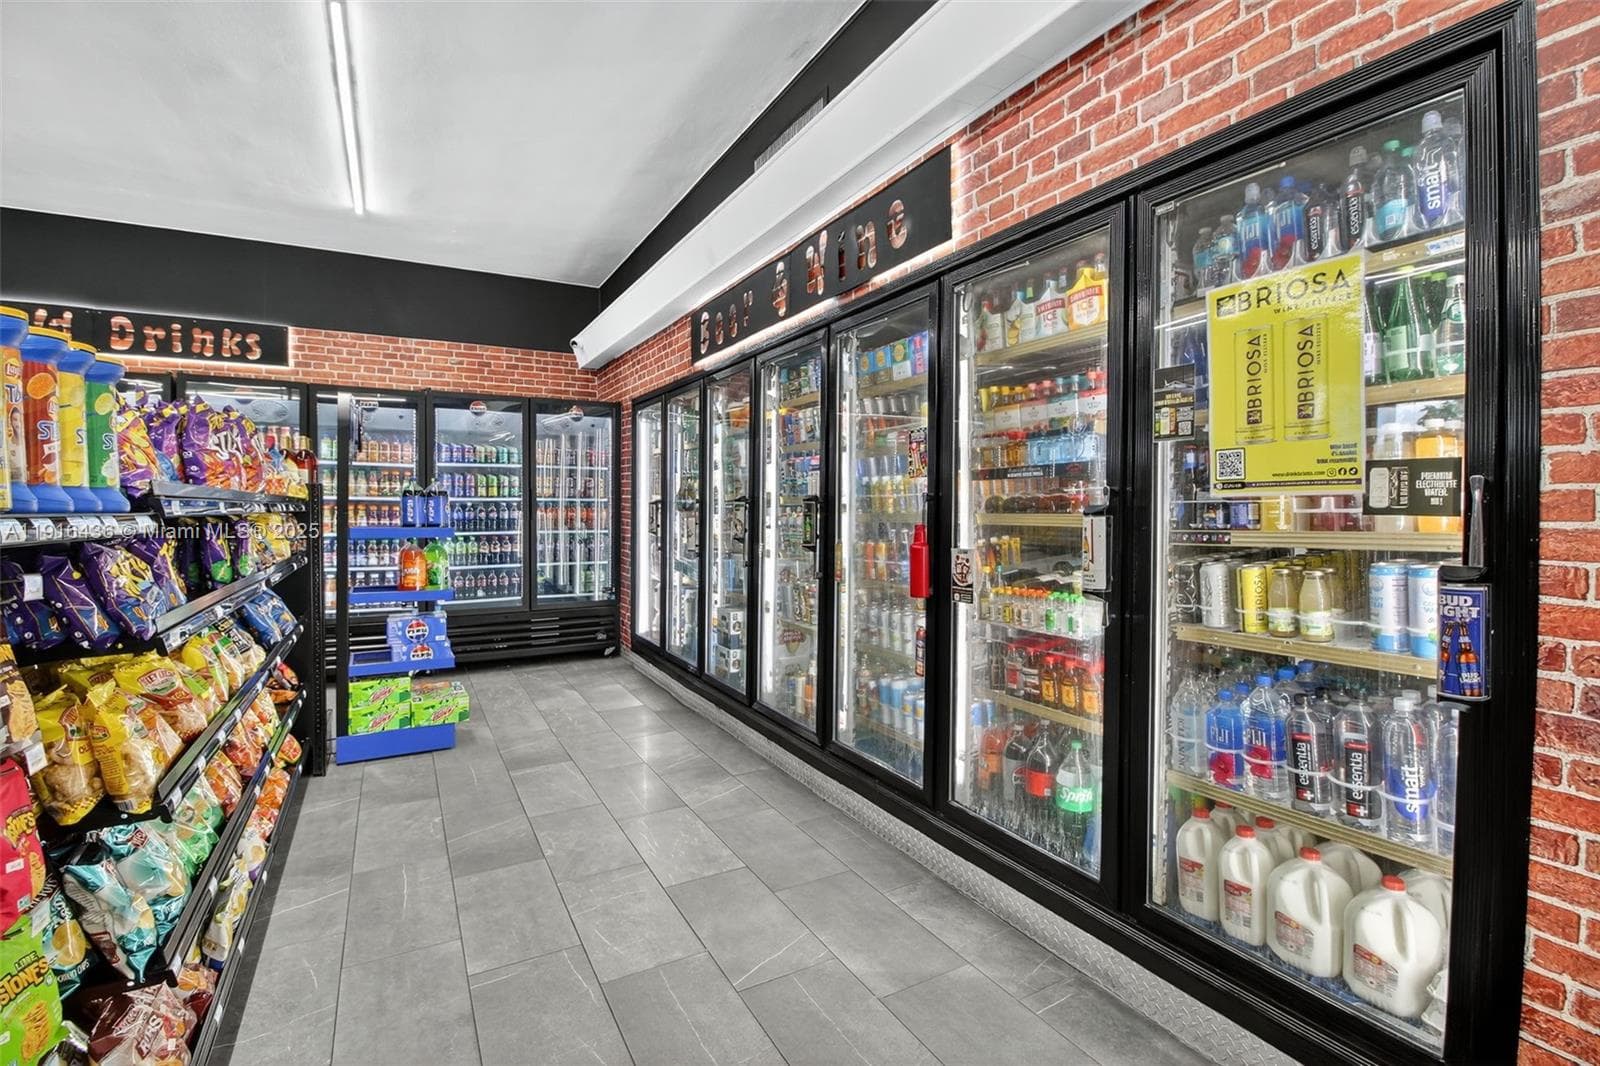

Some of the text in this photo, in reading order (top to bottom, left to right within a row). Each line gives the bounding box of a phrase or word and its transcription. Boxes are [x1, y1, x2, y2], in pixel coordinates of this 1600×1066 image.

[1425, 163, 1441, 209] smart
[806, 199, 908, 295] Wine
[1238, 268, 1351, 313] BRIOSA
[110, 315, 262, 361] Drinks
[1246, 335, 1262, 409] BRIOSA
[1297, 325, 1314, 403] BRIOSA
[1440, 594, 1473, 607] BUD
[1297, 742, 1309, 785] essentia
[1351, 752, 1363, 800] essentia
[1401, 765, 1418, 814] smart
